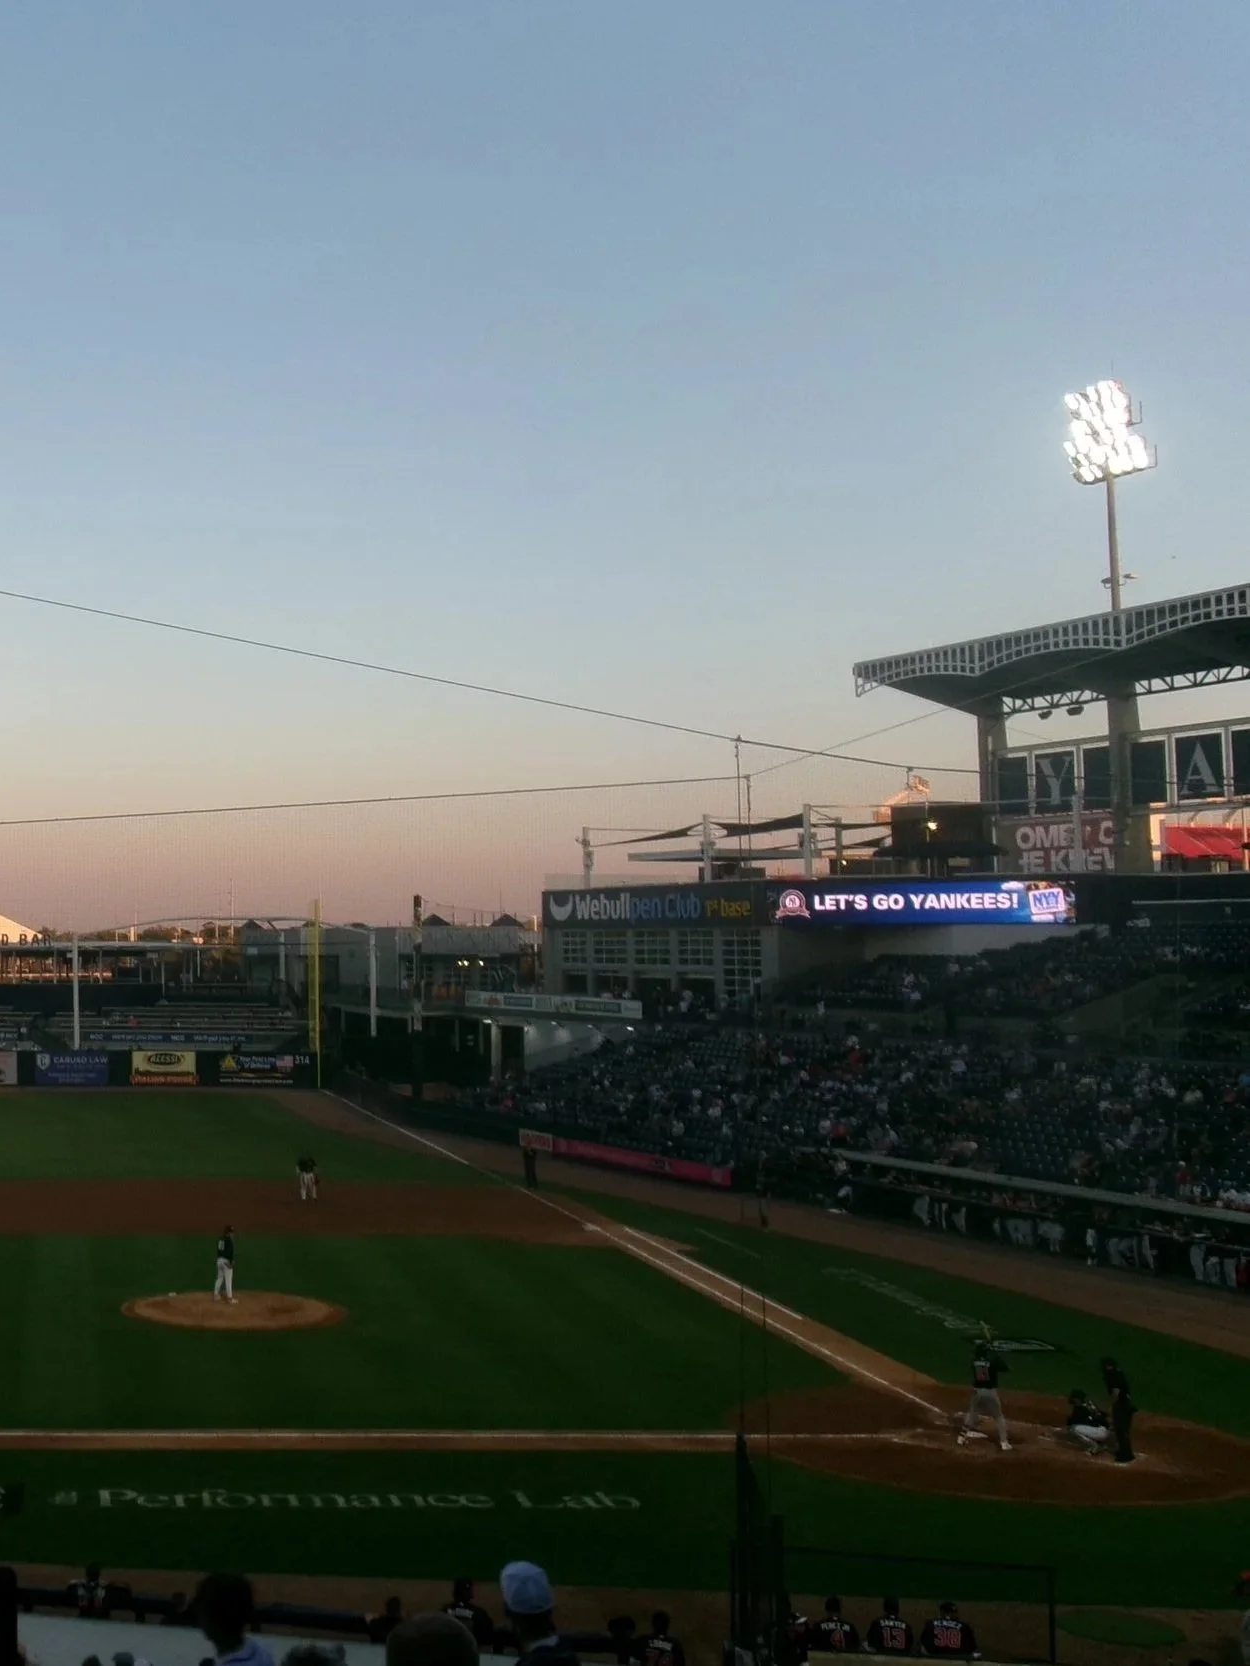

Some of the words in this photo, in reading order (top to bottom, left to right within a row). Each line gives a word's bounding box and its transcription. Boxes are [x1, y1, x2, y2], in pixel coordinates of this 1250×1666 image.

[665, 892, 700, 920] Club
[720, 896, 751, 918] base
[814, 893, 868, 911] LET'S
[872, 893, 905, 910] GO
[909, 891, 1019, 910] YANKEES!
[19, 933, 51, 946] BAR
[53, 1055, 88, 1065] CARUSO
[88, 1055, 109, 1064] LAW
[97, 1488, 497, 1508] Performance
[510, 1489, 642, 1509] Lab
[882, 1628, 906, 1649] 13
